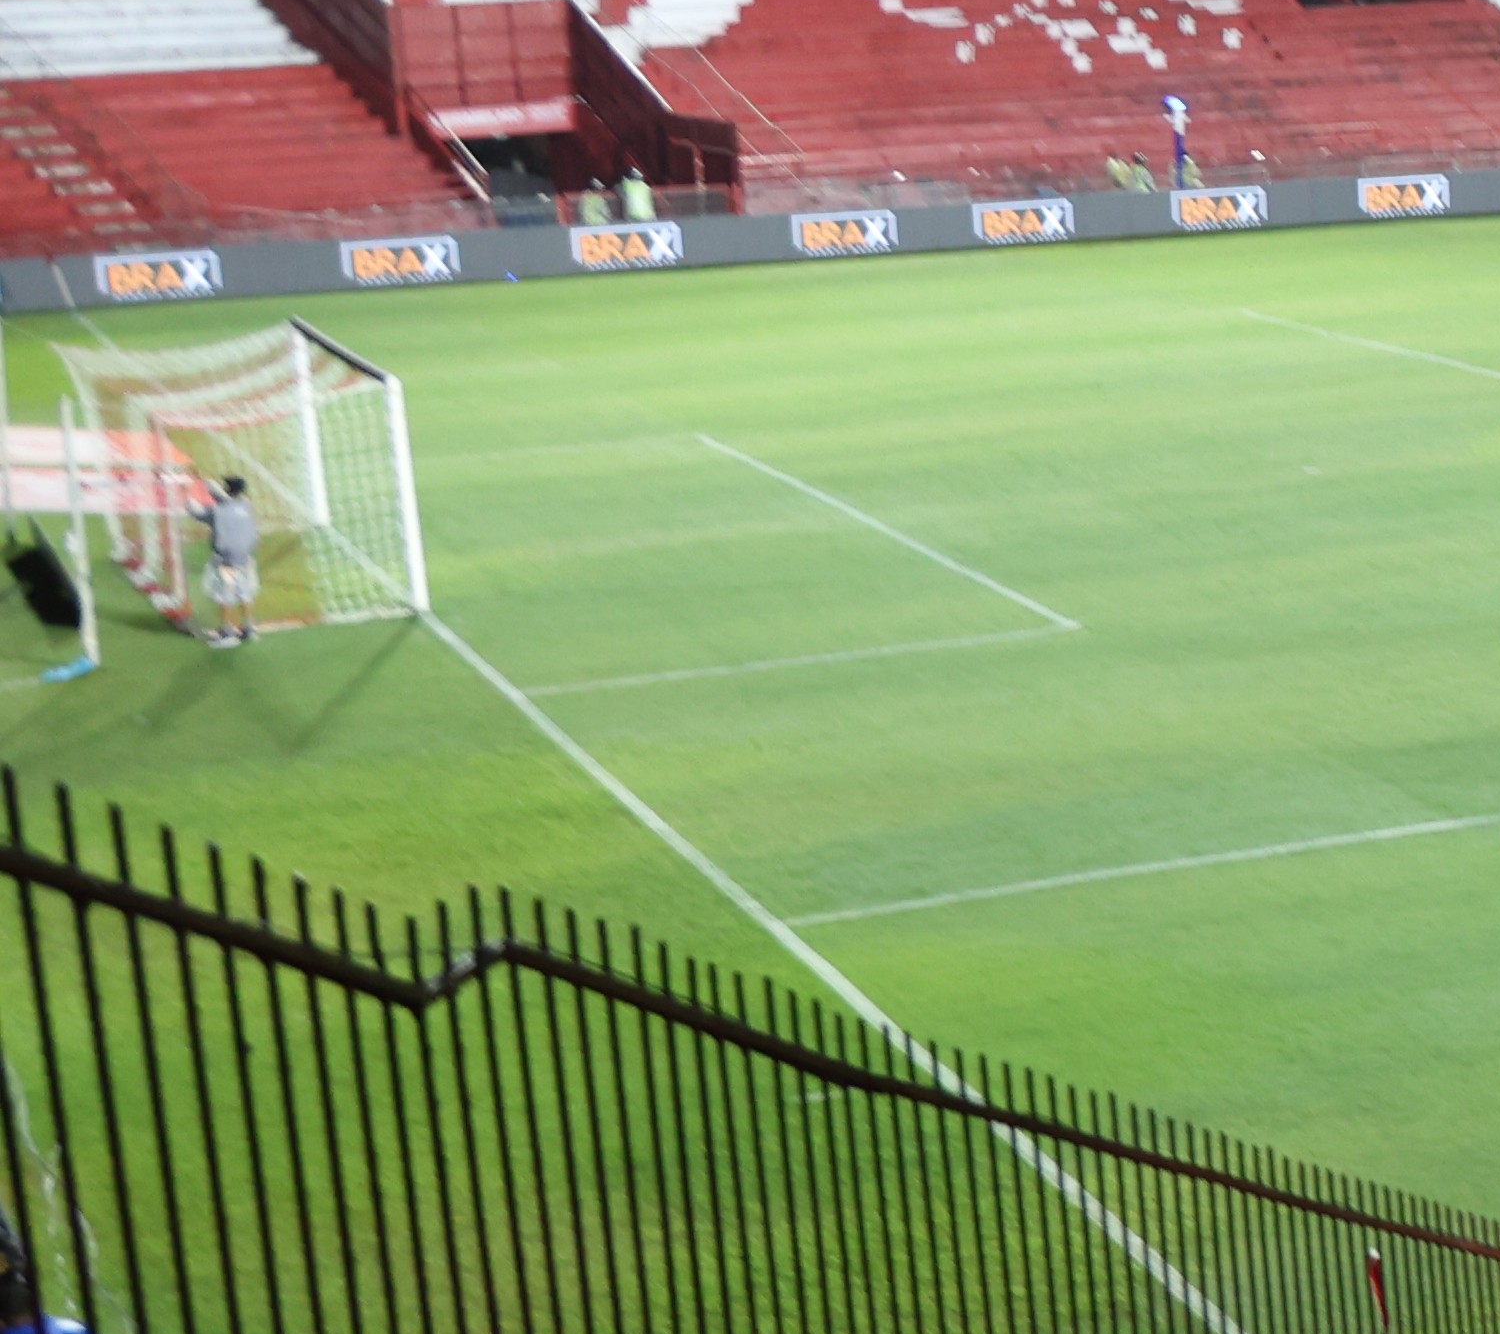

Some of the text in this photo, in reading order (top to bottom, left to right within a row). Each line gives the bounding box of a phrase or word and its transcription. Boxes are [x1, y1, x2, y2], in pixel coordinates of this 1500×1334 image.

[1180, 192, 1260, 222] BRAX
[1366, 180, 1445, 209] BRAX
[802, 216, 888, 247] BRAX
[983, 205, 1068, 236] BRAX
[352, 242, 452, 276] BRAX
[580, 227, 678, 262] BRAX
[107, 257, 214, 292] BRAX
